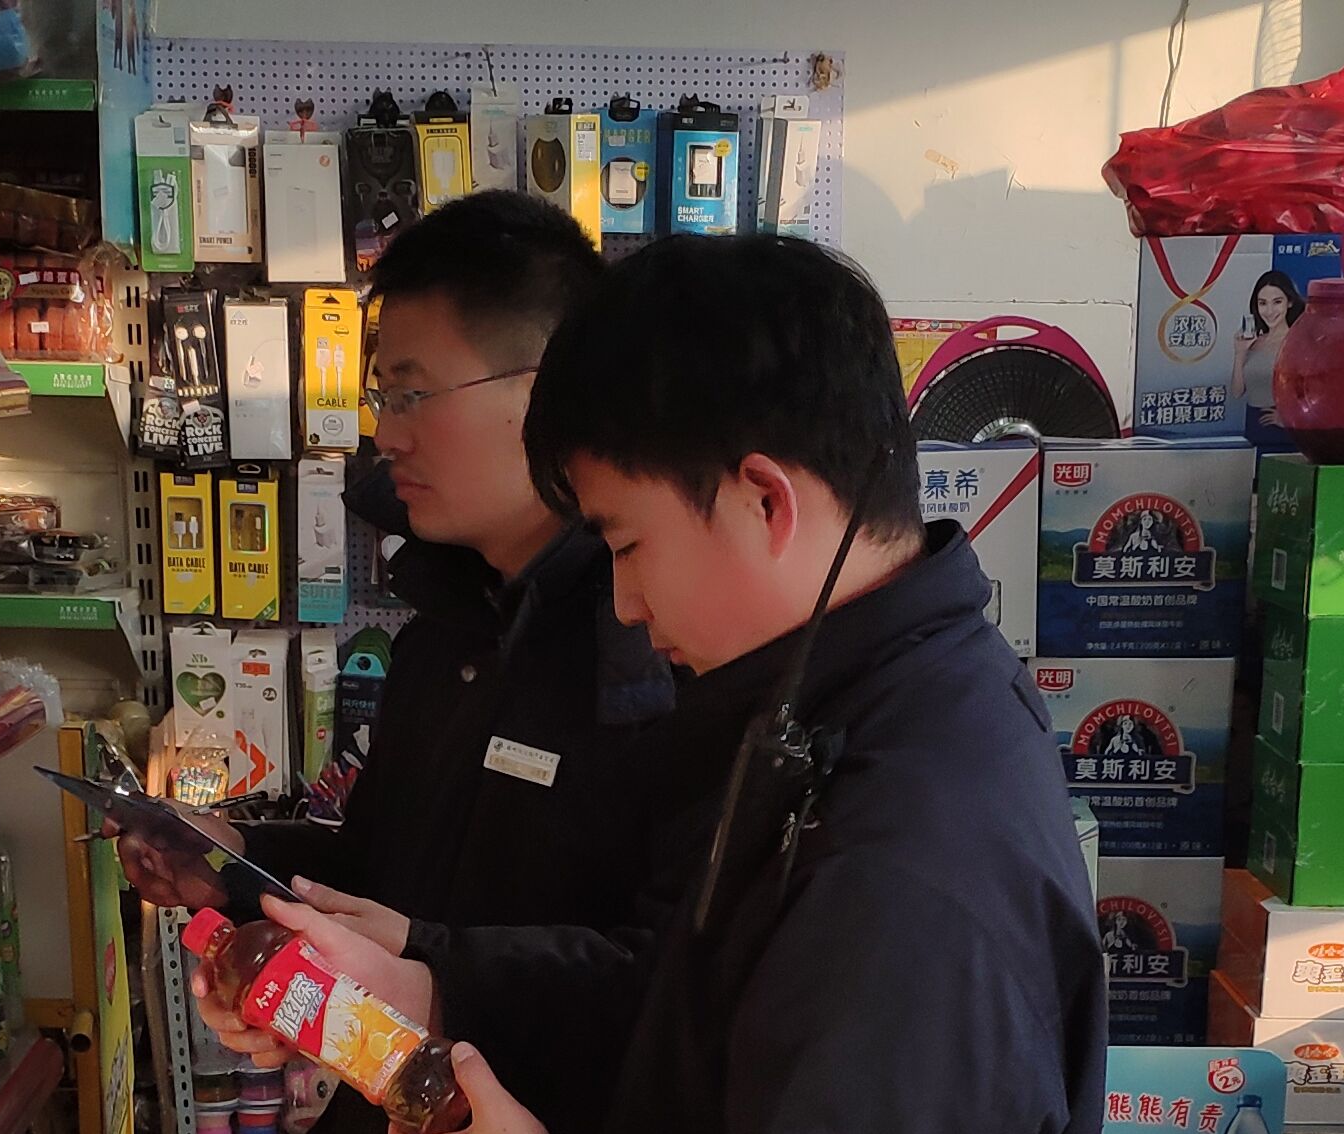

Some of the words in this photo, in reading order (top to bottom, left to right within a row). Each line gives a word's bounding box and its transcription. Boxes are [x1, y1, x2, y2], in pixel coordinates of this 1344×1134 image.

[677, 206, 704, 215] SMART
[677, 213, 714, 223] CHARGER
[1174, 316, 1207, 332] 浓浓
[1168, 331, 1211, 347] 安慕希
[316, 398, 348, 408] CABLE
[1141, 385, 1226, 408] 浓浓安慕希
[1139, 405, 1225, 426] 让相聚更浓
[185, 424, 223, 437] ROCK
[143, 433, 179, 446] LIVE
[186, 434, 223, 444] CONCERT
[188, 441, 223, 456] LIVE
[1056, 464, 1090, 479] 光明
[923, 468, 980, 499] 慕希
[1094, 496, 1200, 545] MOMCHILOVTSI
[167, 557, 184, 568] DATA
[185, 557, 206, 568] CABLE
[229, 562, 246, 574] DATA
[247, 562, 269, 574] CABLE
[1092, 556, 1197, 579] 莫斯利安
[1086, 595, 1199, 608] 中国常温酸奶首创品牌
[1039, 671, 1073, 685] 光明
[1076, 702, 1179, 748] MOMCHILOVTSI
[1074, 759, 1178, 781] 莫斯利安
[1218, 1074, 1242, 1088] 2元
[1107, 1093, 1223, 1134] 熊熊有责
